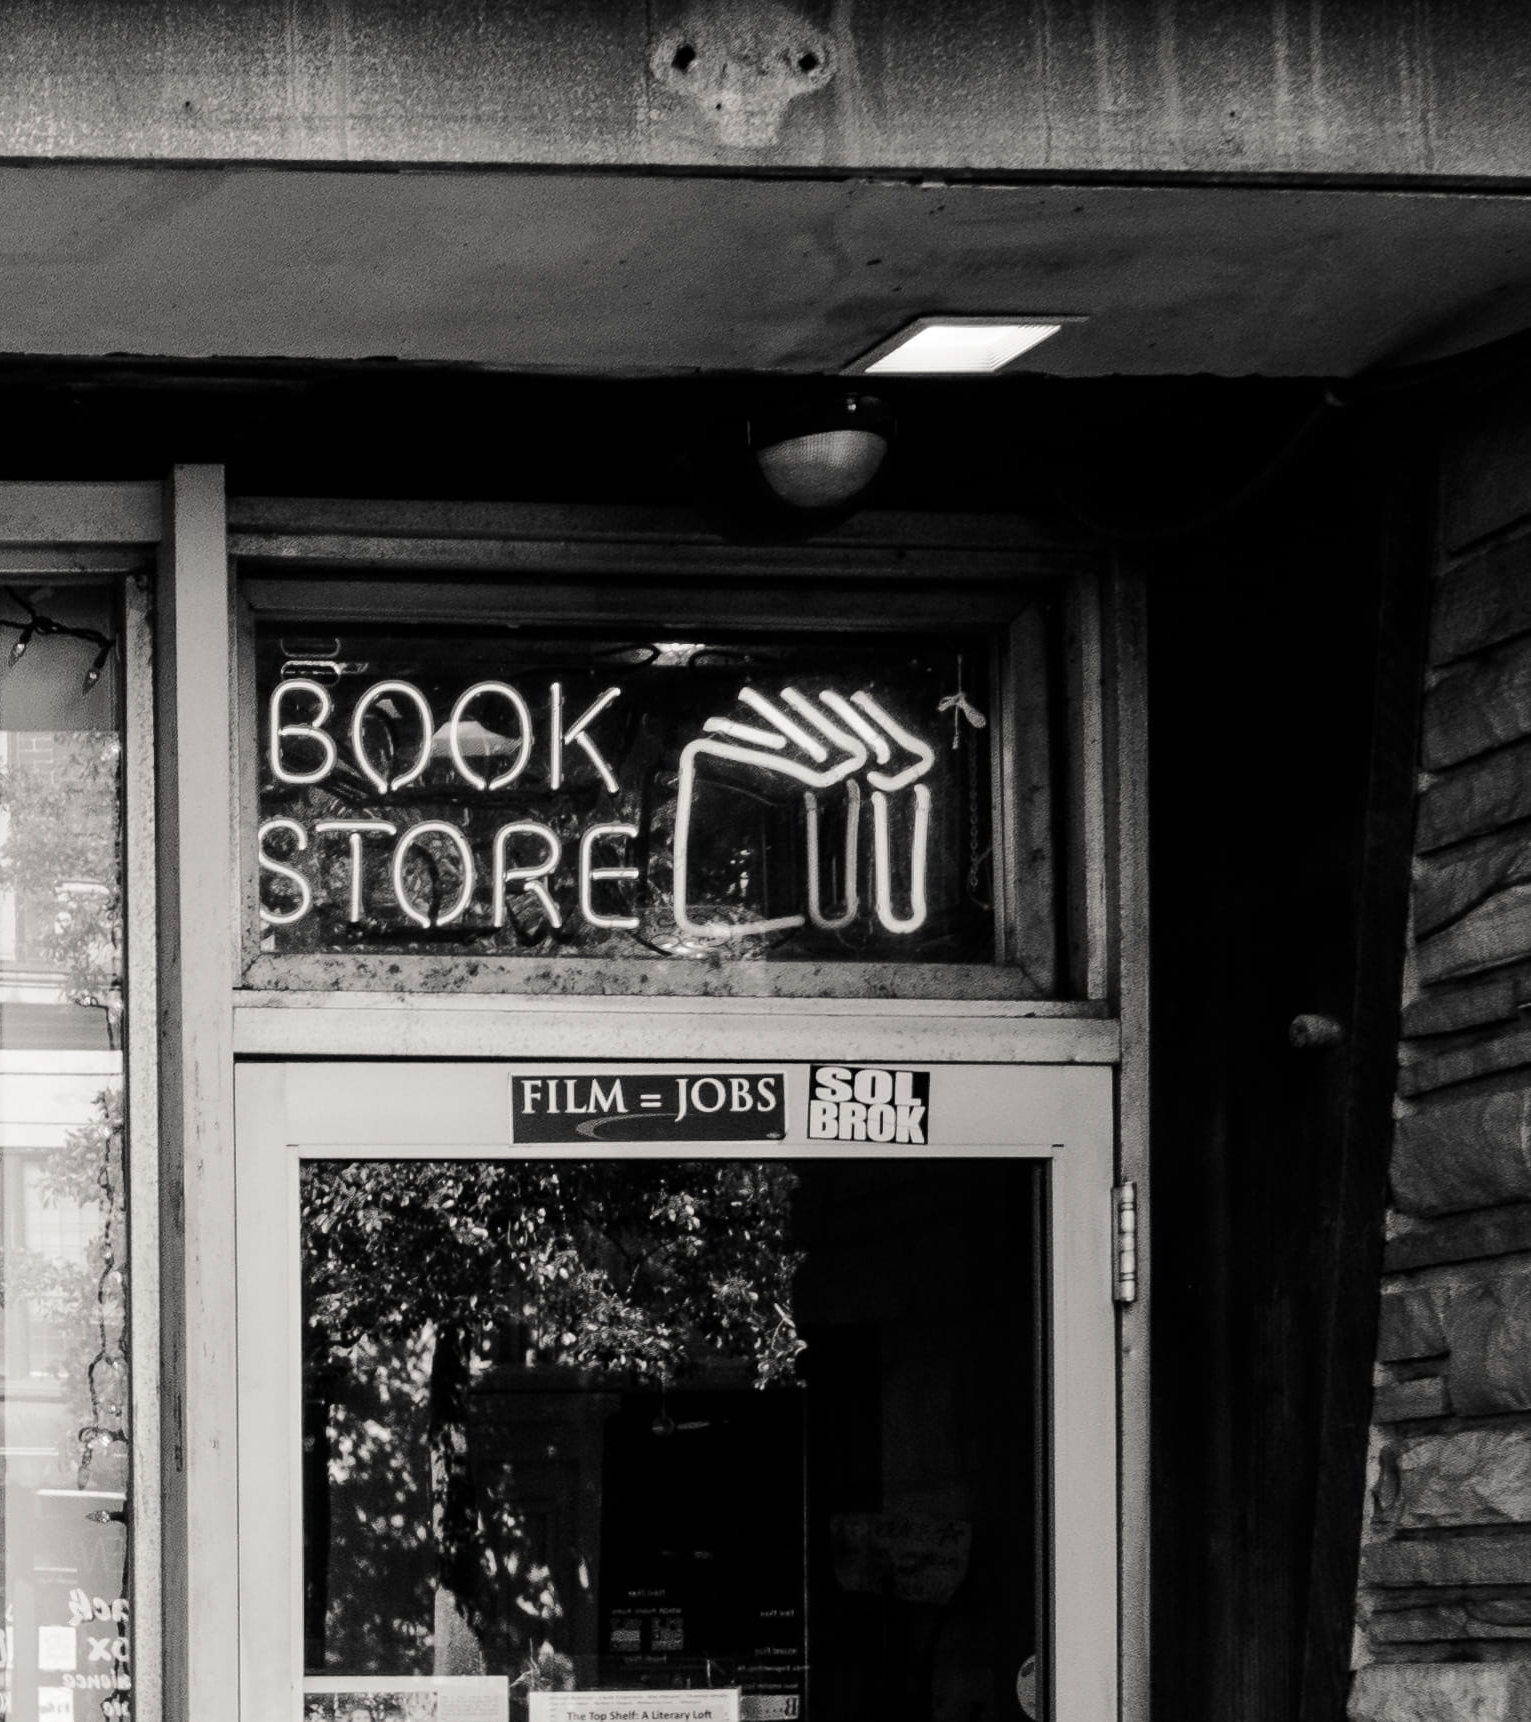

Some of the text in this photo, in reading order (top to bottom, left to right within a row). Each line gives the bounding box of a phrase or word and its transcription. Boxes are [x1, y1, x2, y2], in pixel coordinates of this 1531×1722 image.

[269, 677, 621, 795] BOOK
[257, 816, 640, 929] STORE
[520, 1077, 778, 1123] FILM = JOBS
[814, 1067, 922, 1106] SOL
[808, 1100, 926, 1144] BROK
[566, 1710, 712, 1722] The Top Shelf: A Literary Loft
